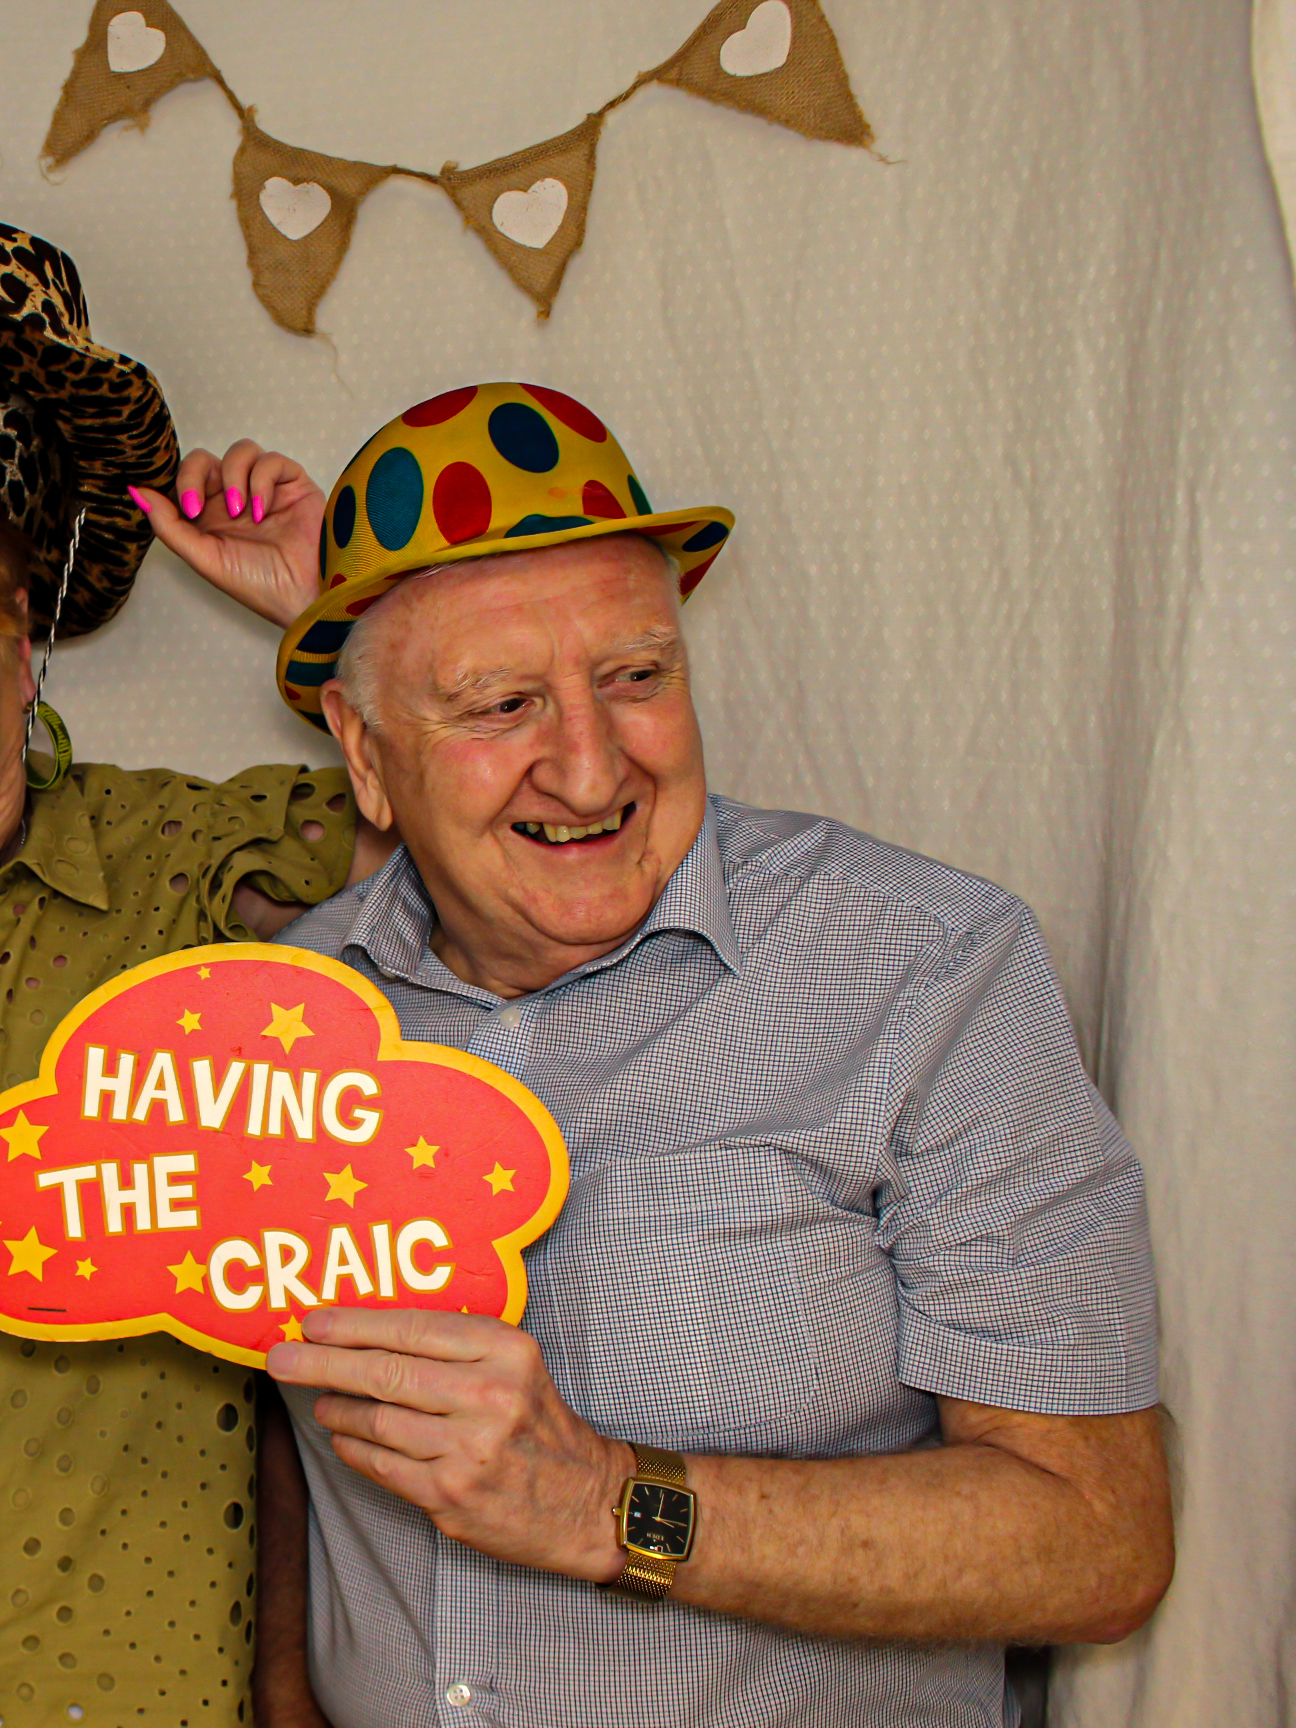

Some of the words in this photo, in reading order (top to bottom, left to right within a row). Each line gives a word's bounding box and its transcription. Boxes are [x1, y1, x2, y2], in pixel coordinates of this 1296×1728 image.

[83, 1045, 381, 1144] HAVING
[36, 1153, 200, 1239] THE
[208, 1218, 453, 1311] CRAIC
